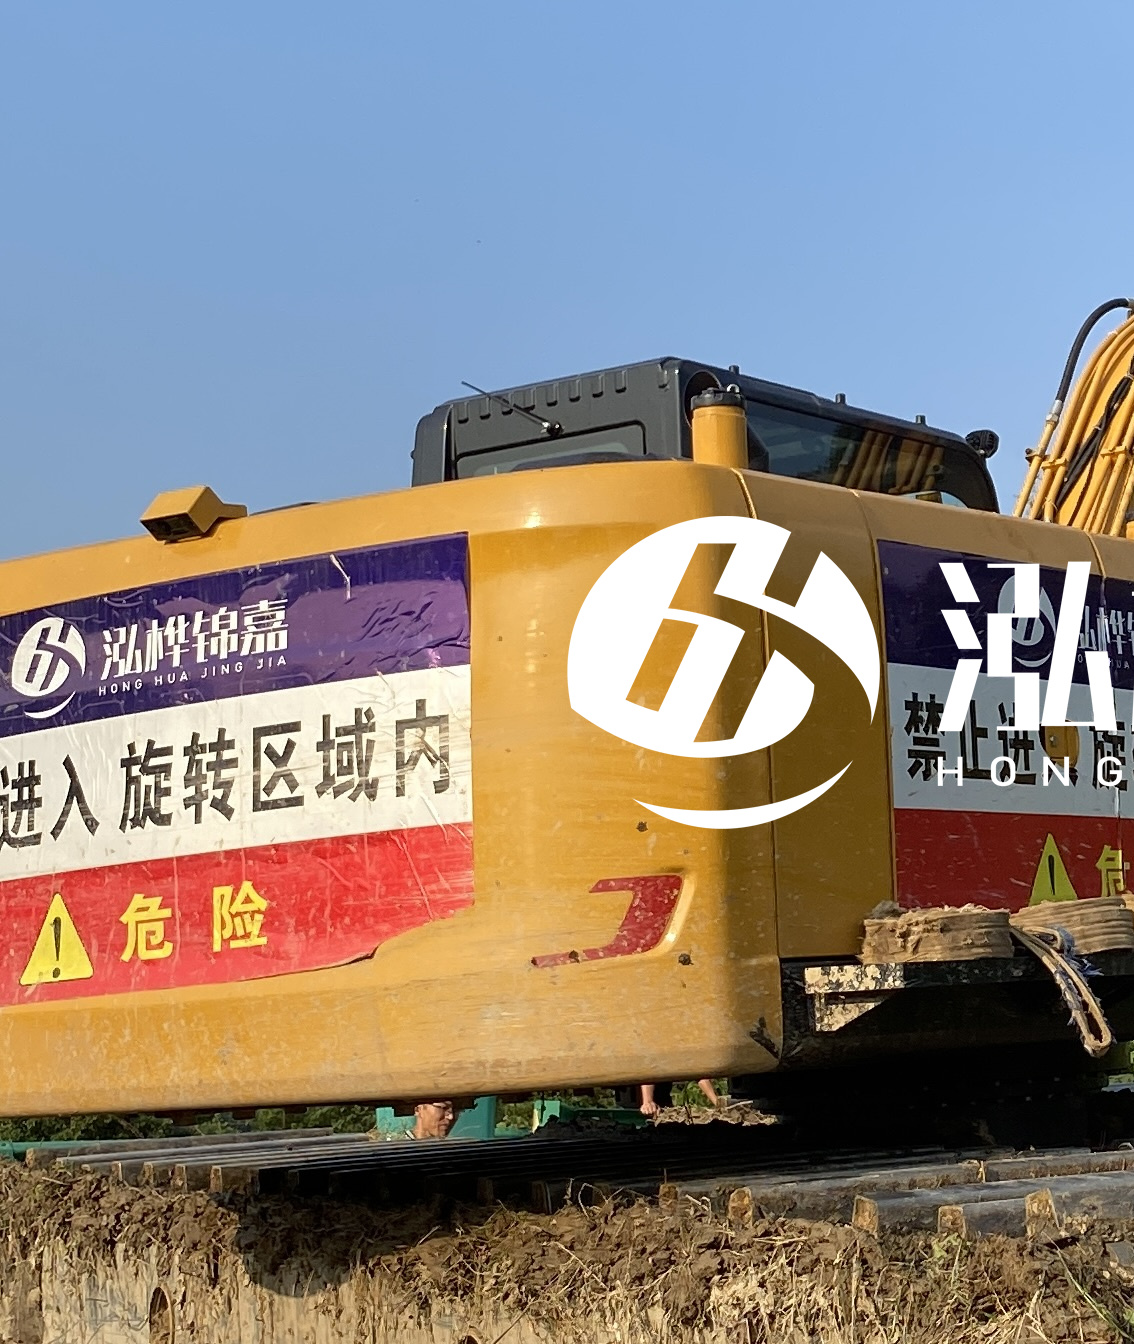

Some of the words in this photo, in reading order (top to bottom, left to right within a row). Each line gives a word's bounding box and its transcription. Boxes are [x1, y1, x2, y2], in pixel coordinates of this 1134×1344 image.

[98, 679, 144, 697] HONG
[154, 670, 190, 686] HUA
[200, 661, 245, 680] JING
[256, 655, 288, 671] JIA
[103, 600, 289, 680] 泓桦锦嘉
[120, 881, 268, 962] 危险
